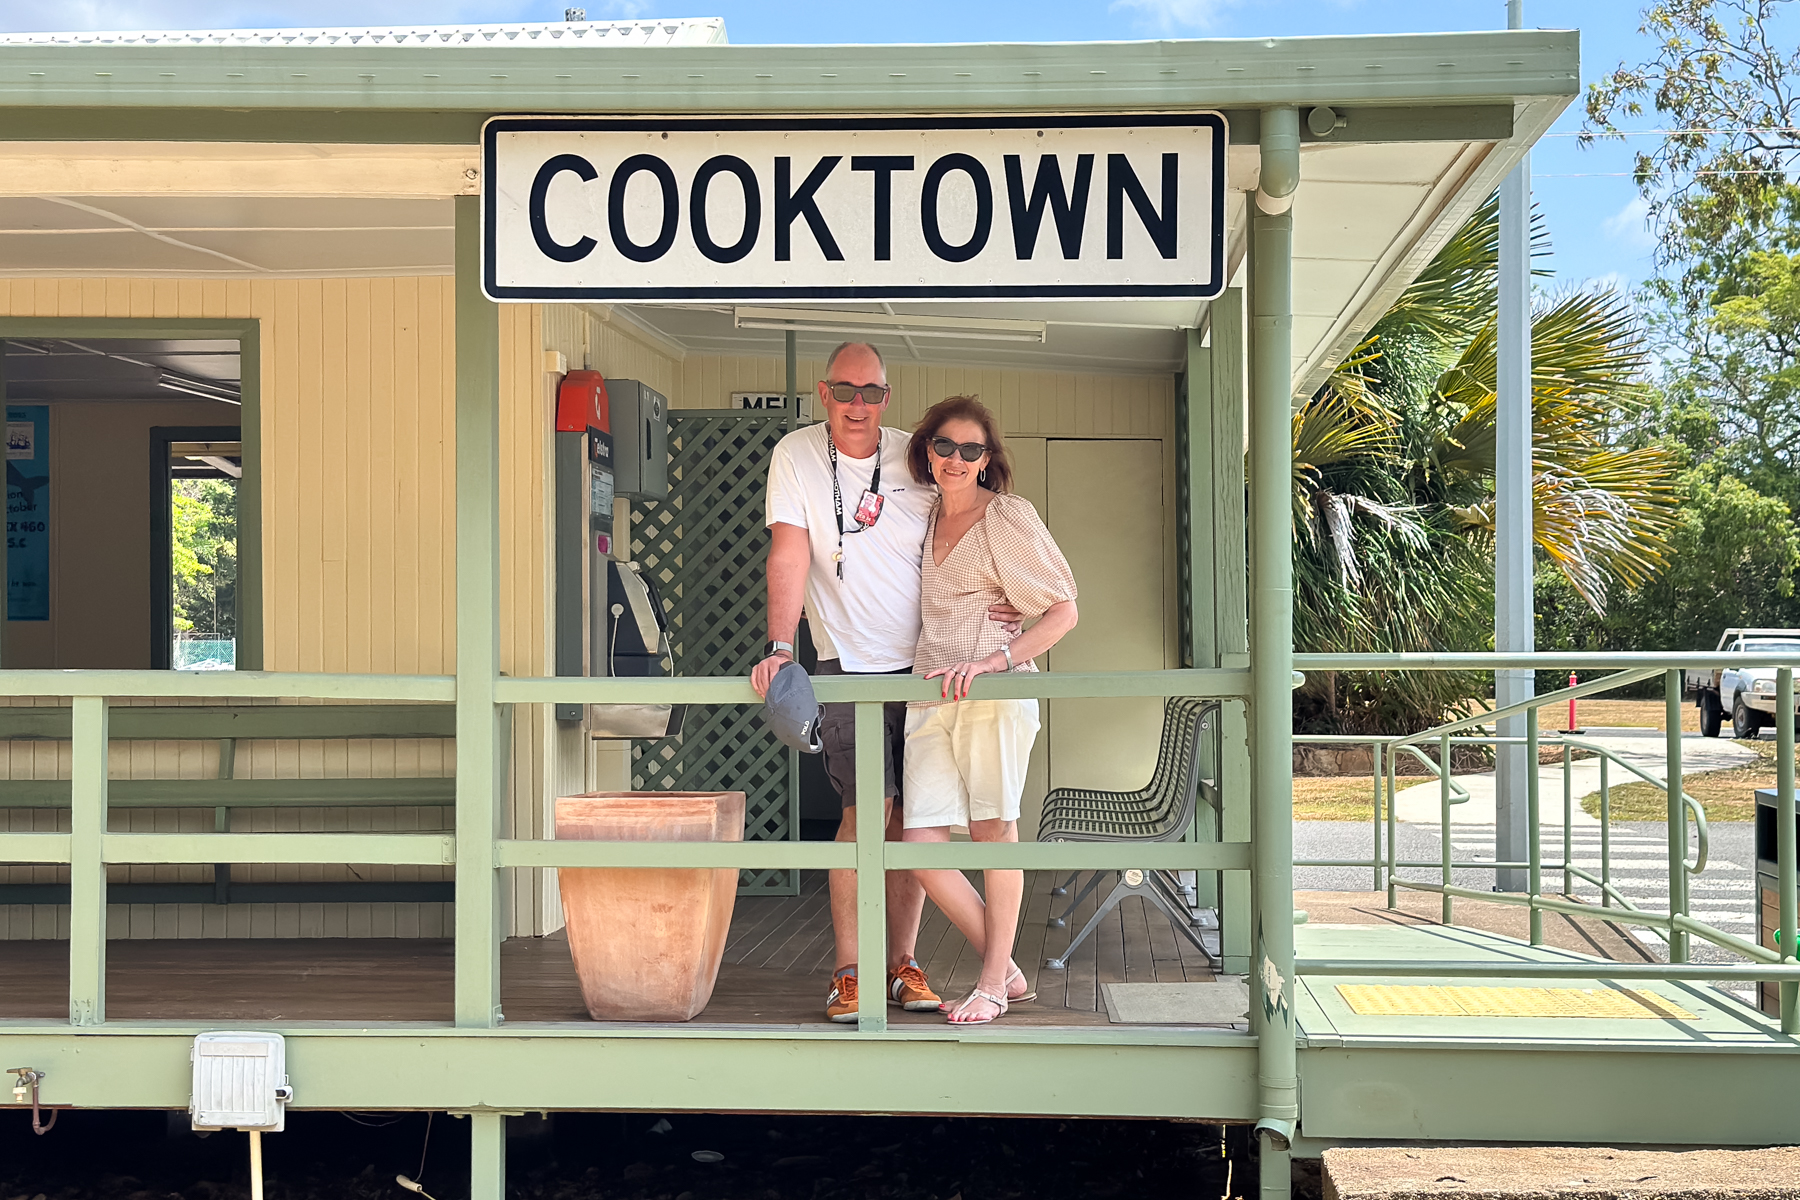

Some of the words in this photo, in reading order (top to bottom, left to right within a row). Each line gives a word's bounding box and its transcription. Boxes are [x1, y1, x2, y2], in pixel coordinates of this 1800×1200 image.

[528, 152, 1179, 263] COOKTOWN
[594, 437, 609, 459] Telstra
[7, 502, 37, 513] tober
[801, 721, 810, 736] POLO
